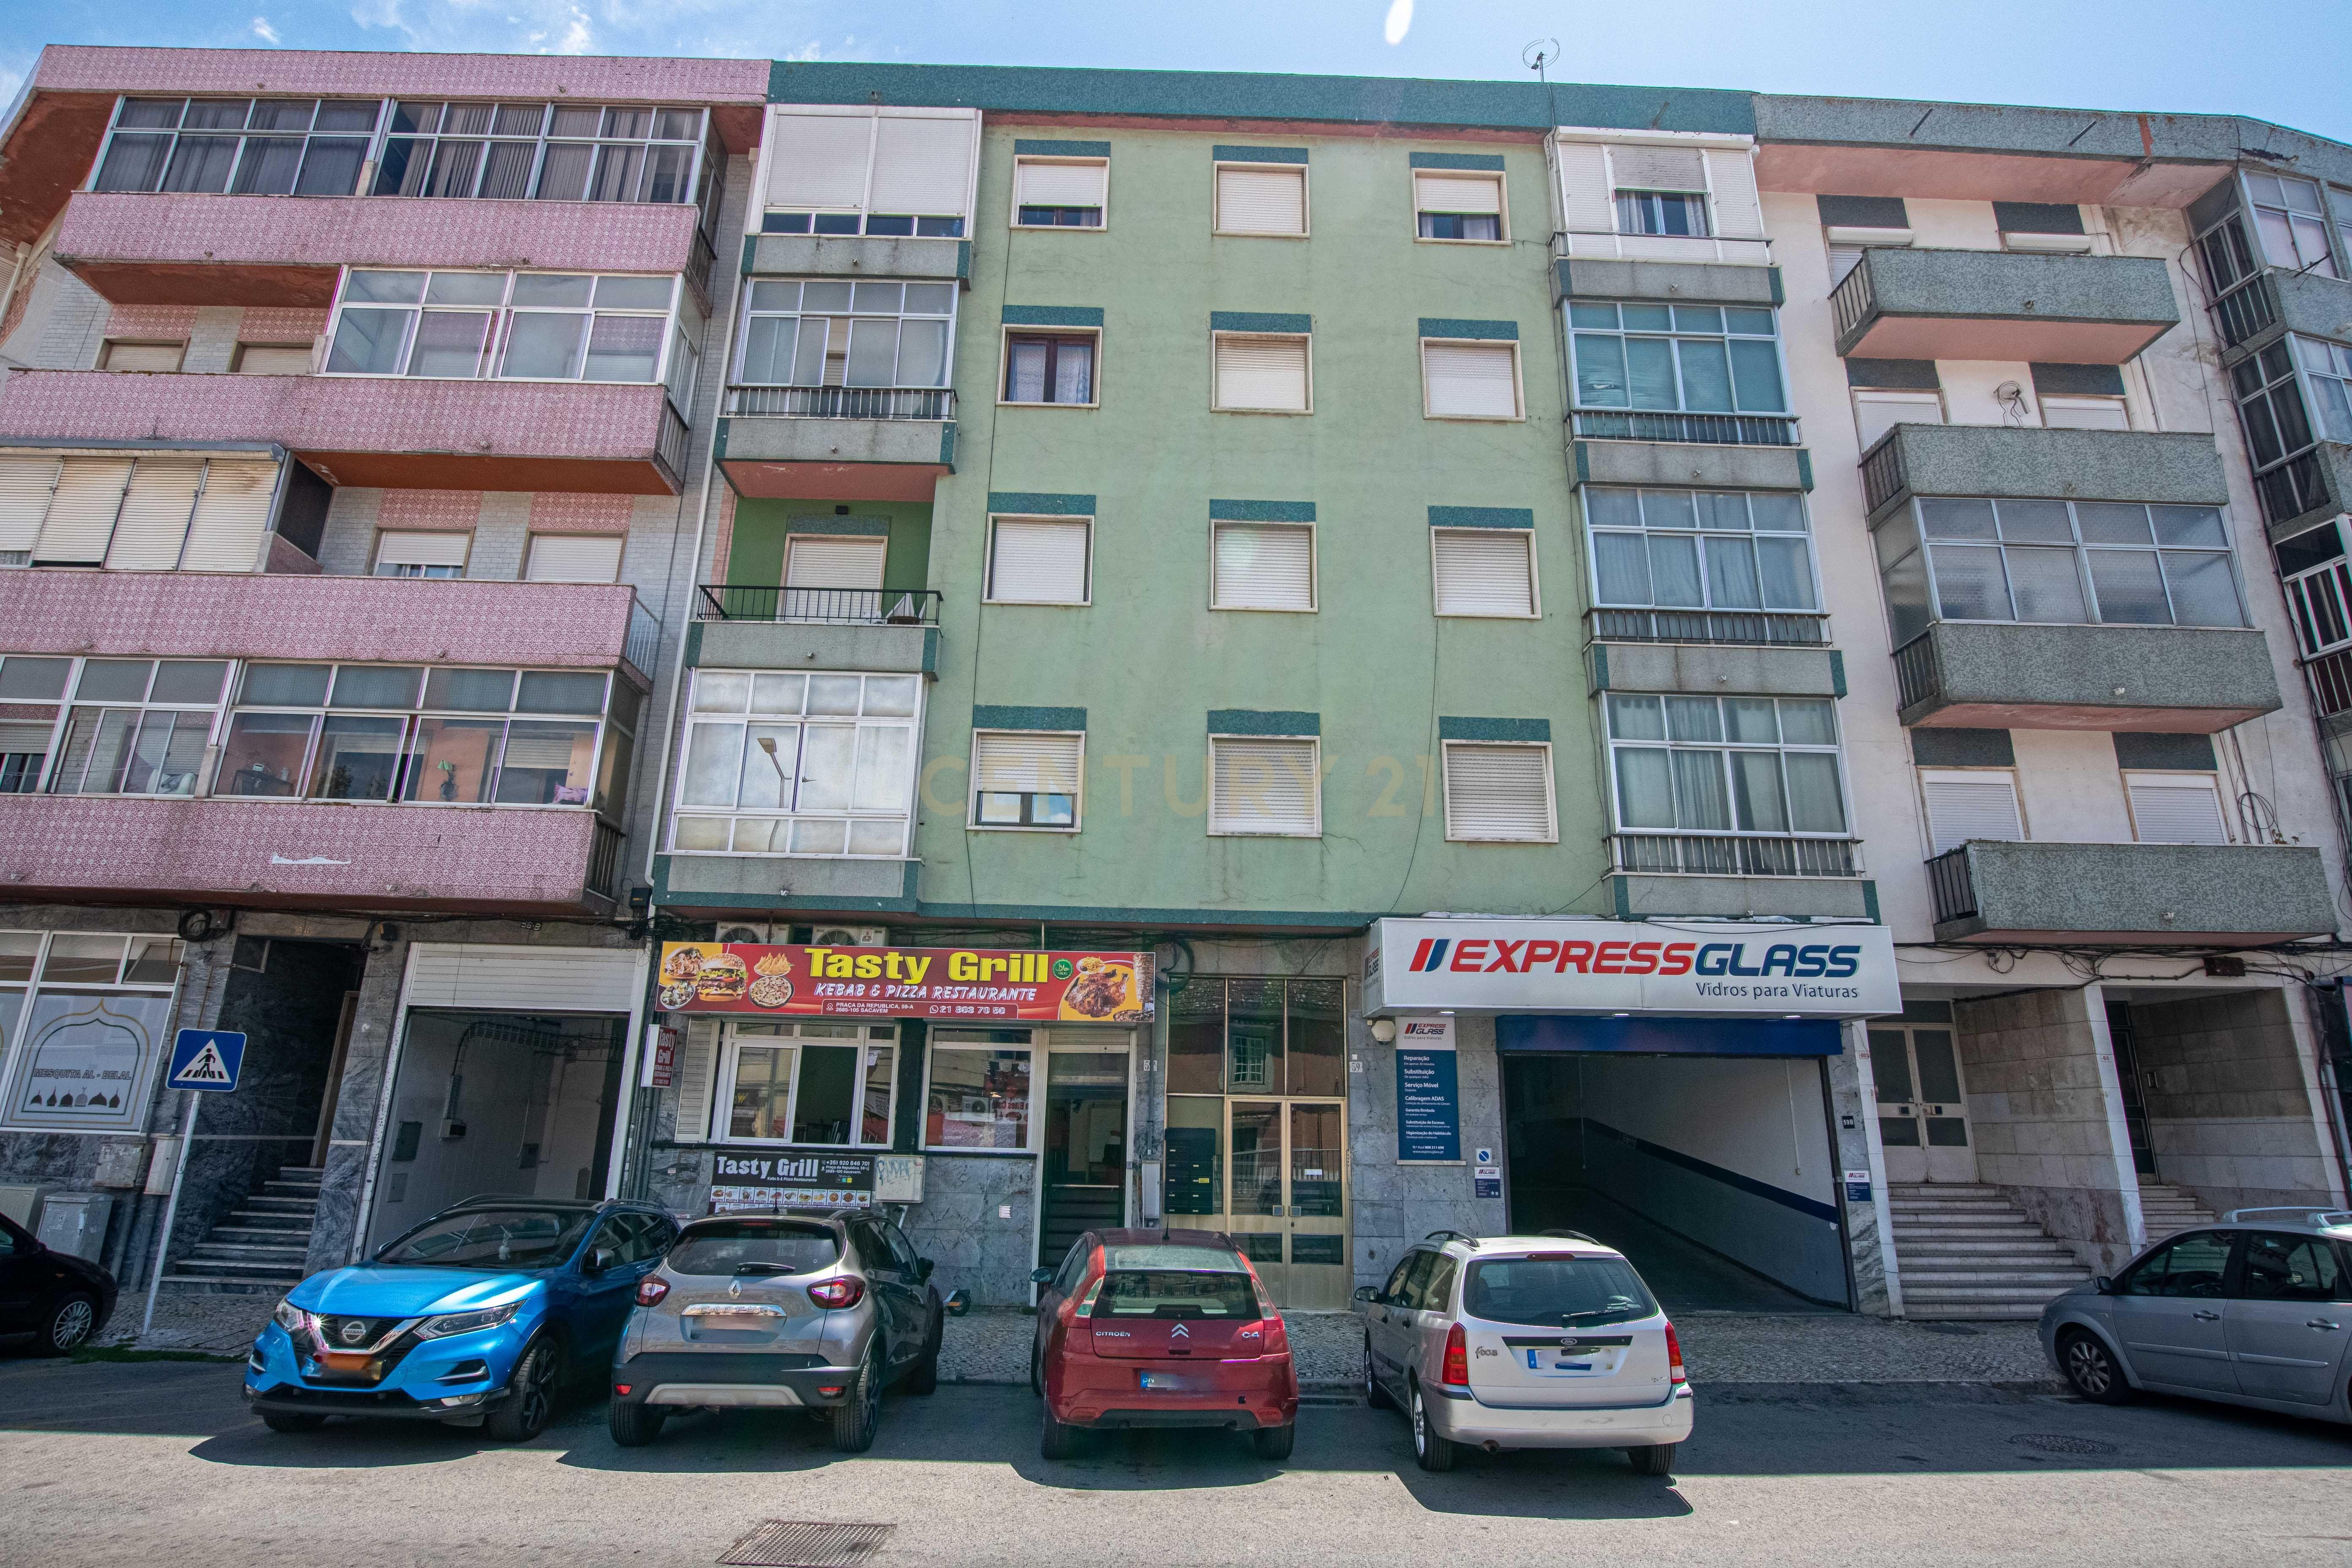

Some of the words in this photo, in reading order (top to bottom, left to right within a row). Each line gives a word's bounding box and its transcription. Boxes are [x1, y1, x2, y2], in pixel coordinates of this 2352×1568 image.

[804, 948, 931, 984] Tasty
[948, 952, 1049, 983] Grill
[814, 983, 864, 996] KEBAB
[870, 984, 880, 996] &
[885, 985, 927, 999] PIZZA
[932, 986, 1037, 1001] RESTAURANTE
[1696, 981, 1750, 999] Vidros
[1753, 986, 1790, 1001] para
[1792, 983, 1859, 999] Viaturas
[658, 1029, 676, 1051] Tasty
[658, 1049, 671, 1064] Grill
[33, 1068, 81, 1079] MESQUITA
[82, 1070, 95, 1079] AL
[101, 1070, 132, 1080] BELAL
[1352, 1063, 1360, 1072] 59
[717, 1157, 771, 1179] Tasty
[777, 1158, 819, 1177] Grill
